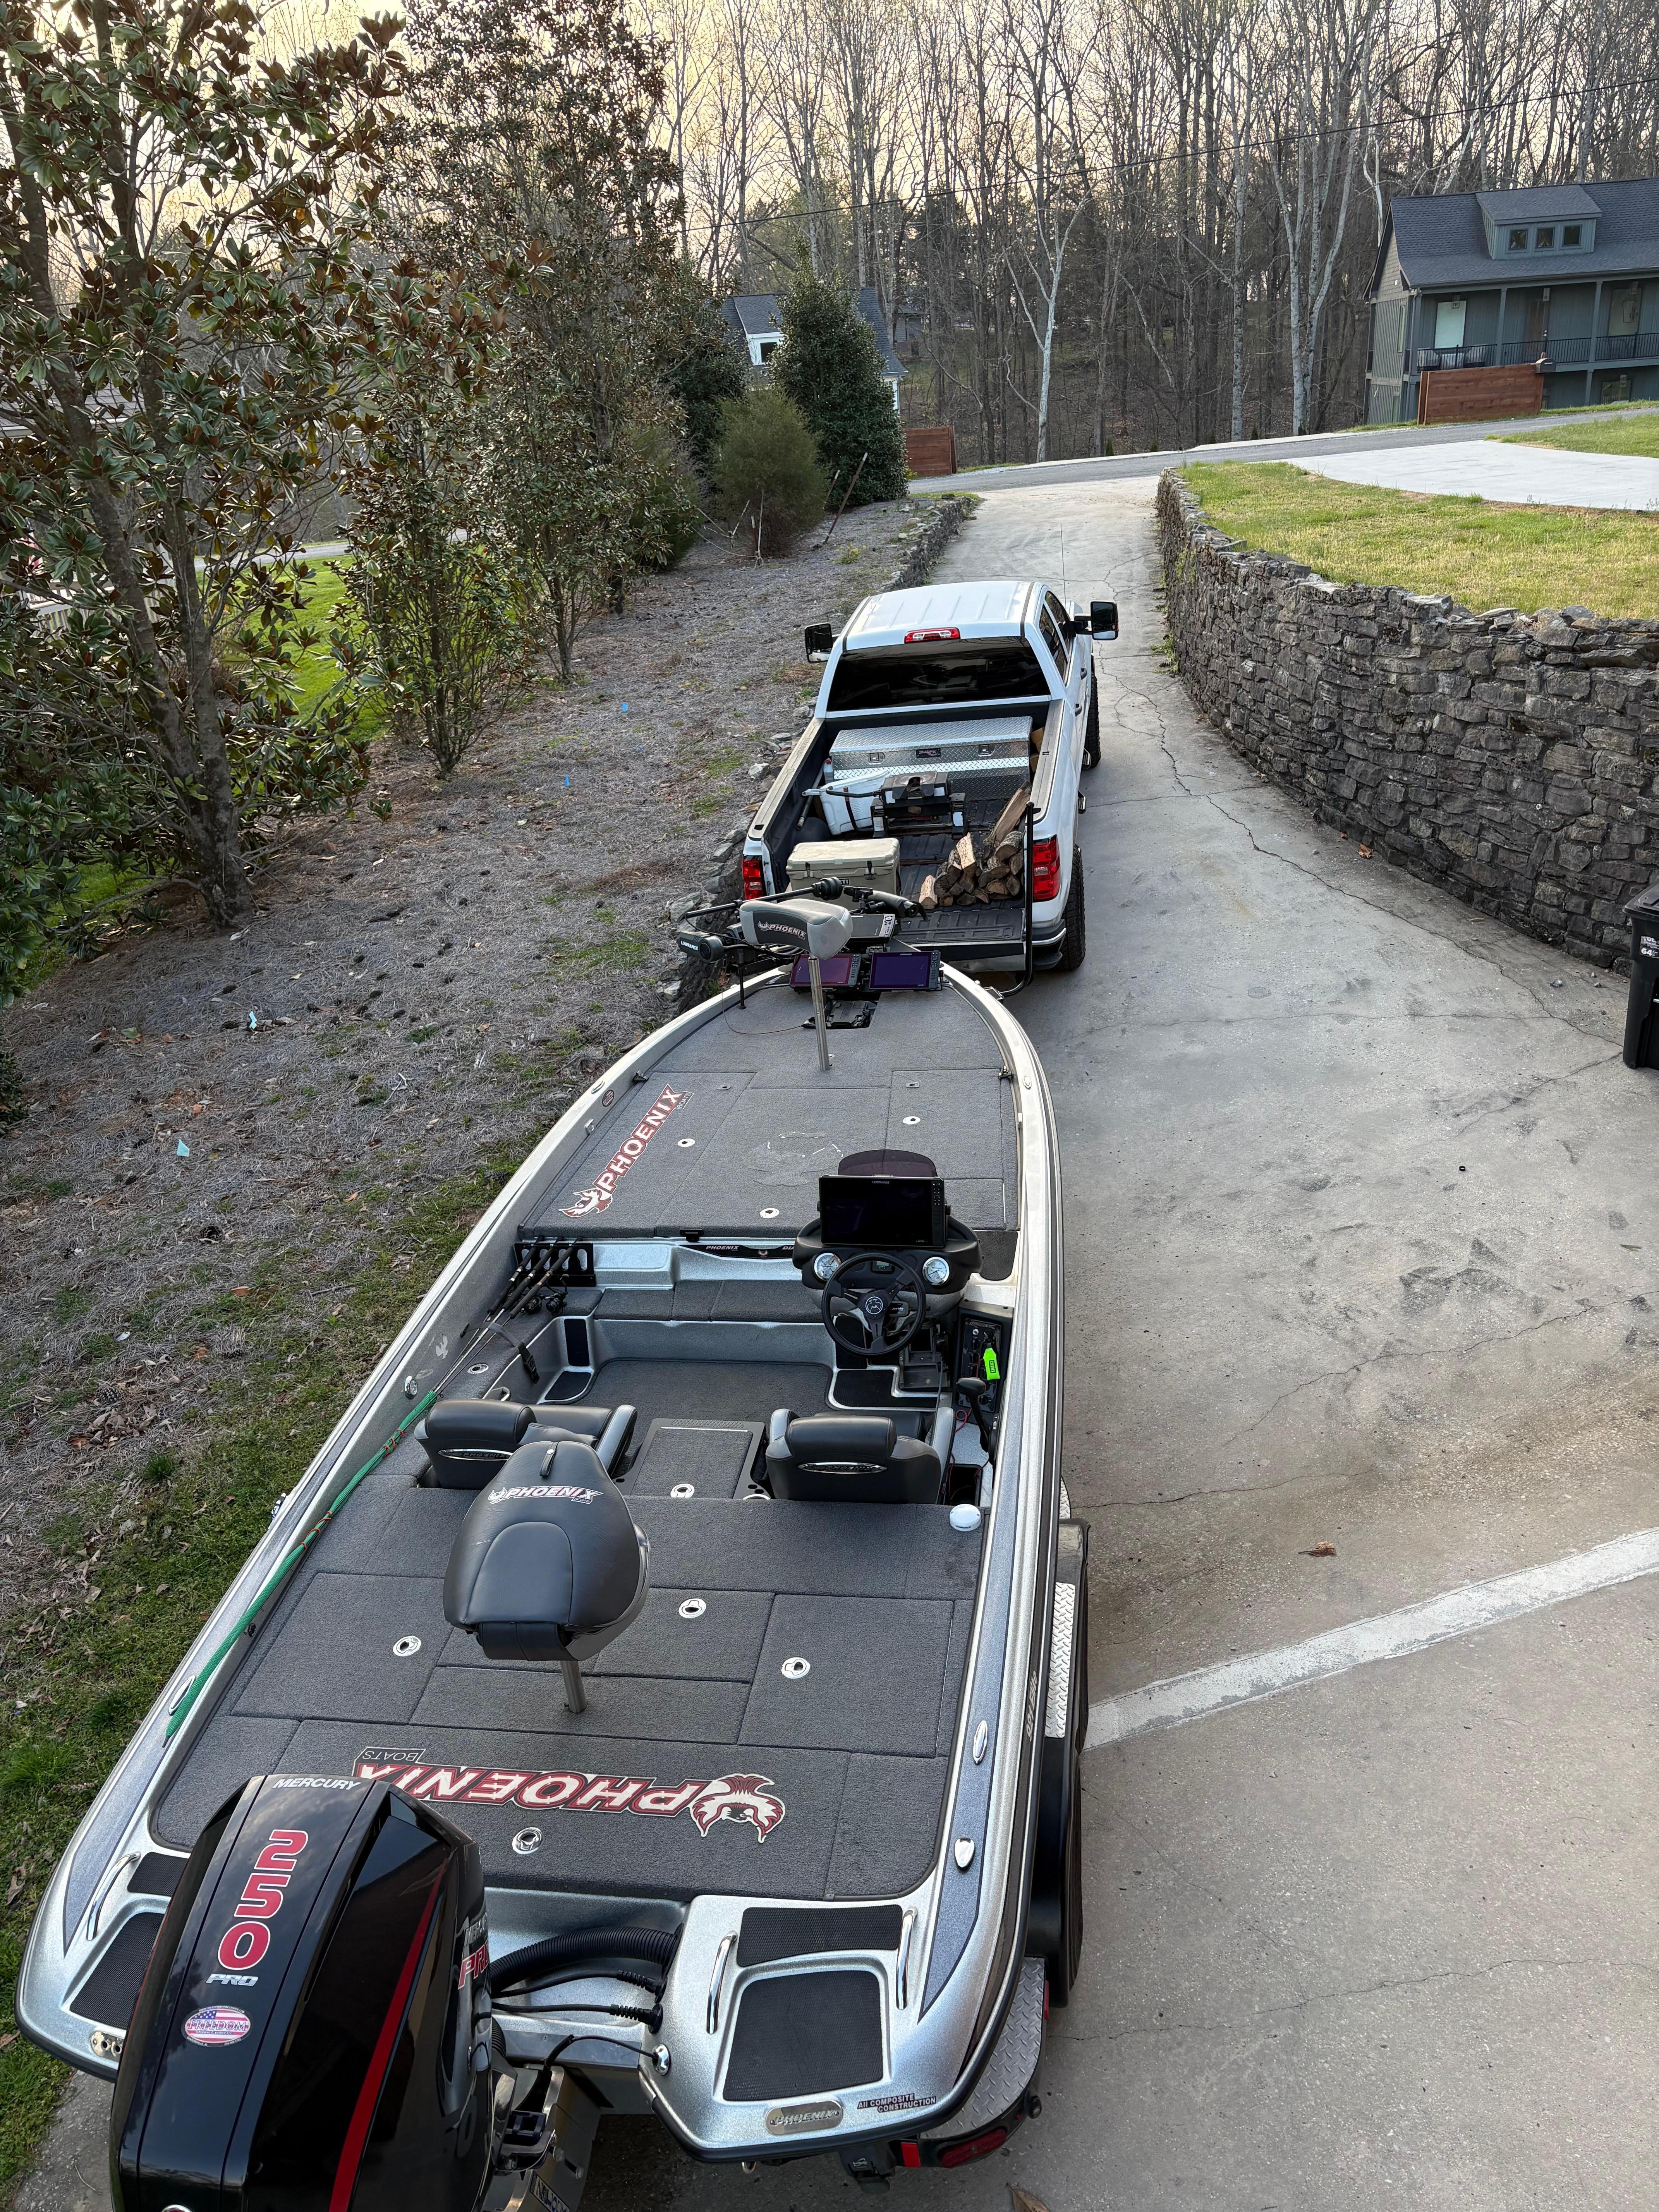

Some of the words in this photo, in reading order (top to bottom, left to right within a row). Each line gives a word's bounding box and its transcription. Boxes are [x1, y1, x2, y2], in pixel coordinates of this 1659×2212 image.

[769, 924, 806, 937] PHOENIX
[681, 941, 698, 951] LOWRANCE
[677, 1092, 691, 1108] BOATS
[595, 1087, 682, 1193] PHOENIX
[504, 1486, 601, 1499] PHOENIX
[362, 1750, 420, 1762] BOATS
[272, 1778, 362, 1790] MERCURY
[218, 1829, 309, 1970] 250
[206, 1973, 259, 1986] PRO
[188, 2019, 247, 2032] FREEDOM
[870, 2094, 914, 2106] COMPOSITE
[878, 2097, 936, 2112] CONSTRUCTION
[774, 2110, 835, 2126] PHOENIX
